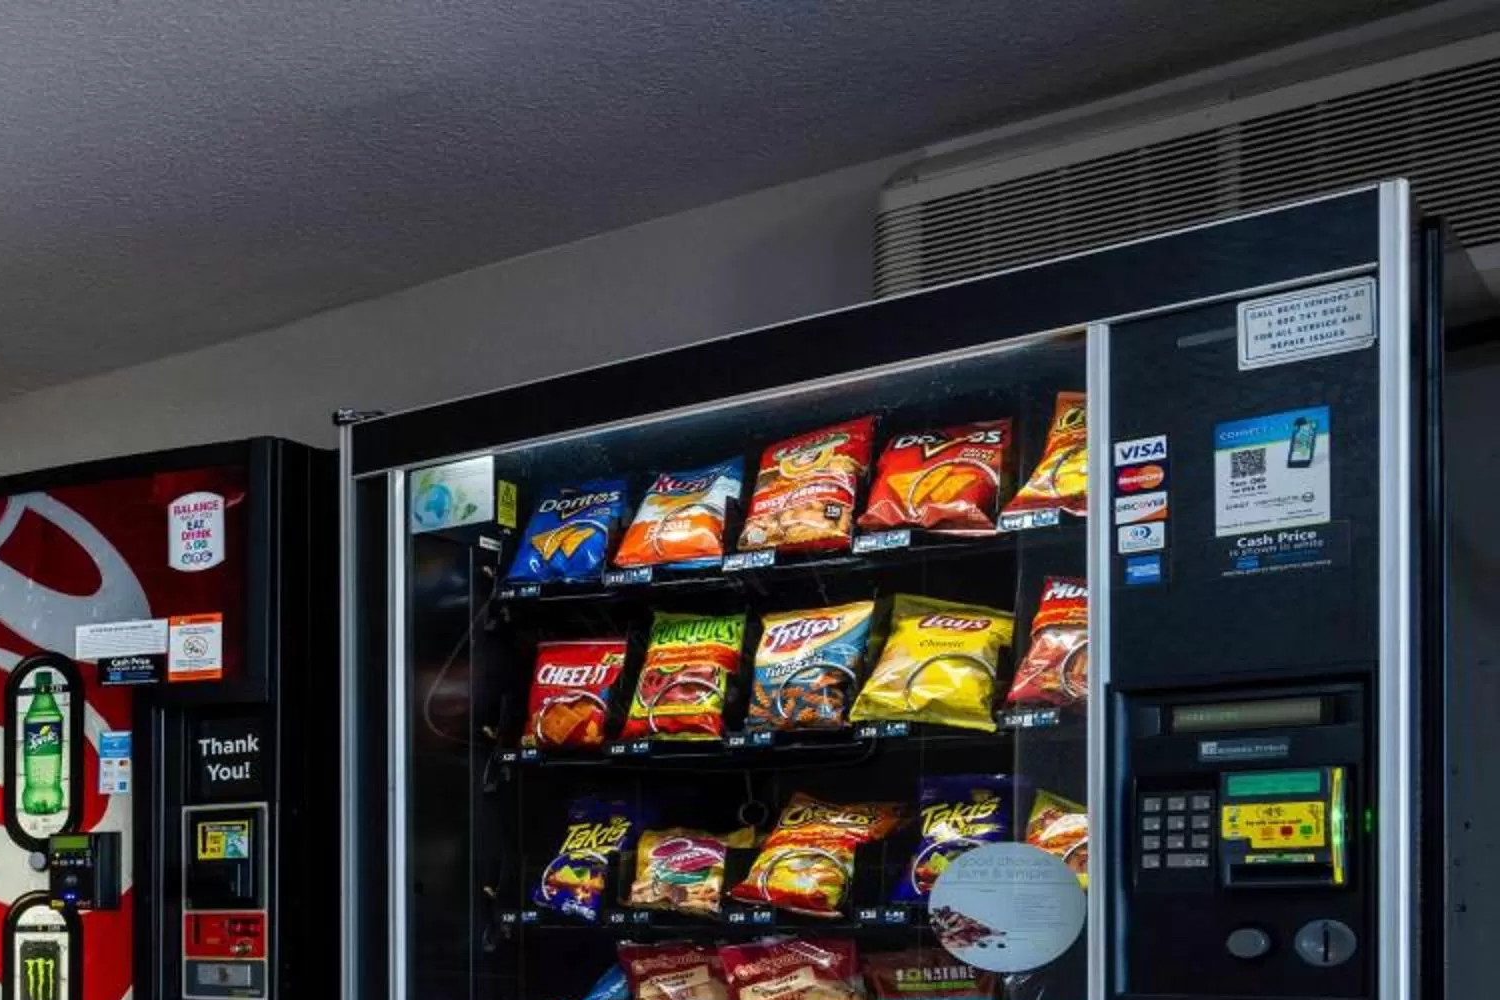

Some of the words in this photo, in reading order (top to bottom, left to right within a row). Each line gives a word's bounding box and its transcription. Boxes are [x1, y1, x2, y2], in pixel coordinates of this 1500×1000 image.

[1120, 441, 1165, 460] VISA
[173, 500, 220, 515] BALANCE
[538, 489, 621, 514] Doritos
[187, 520, 205, 530] EAT
[180, 530, 212, 541] DRINK
[1237, 534, 1273, 549] Cash
[1278, 529, 1318, 543] Price
[767, 617, 841, 651] Fritos
[198, 734, 260, 757] Thank
[207, 761, 251, 782] You!
[561, 816, 633, 853] Takis
